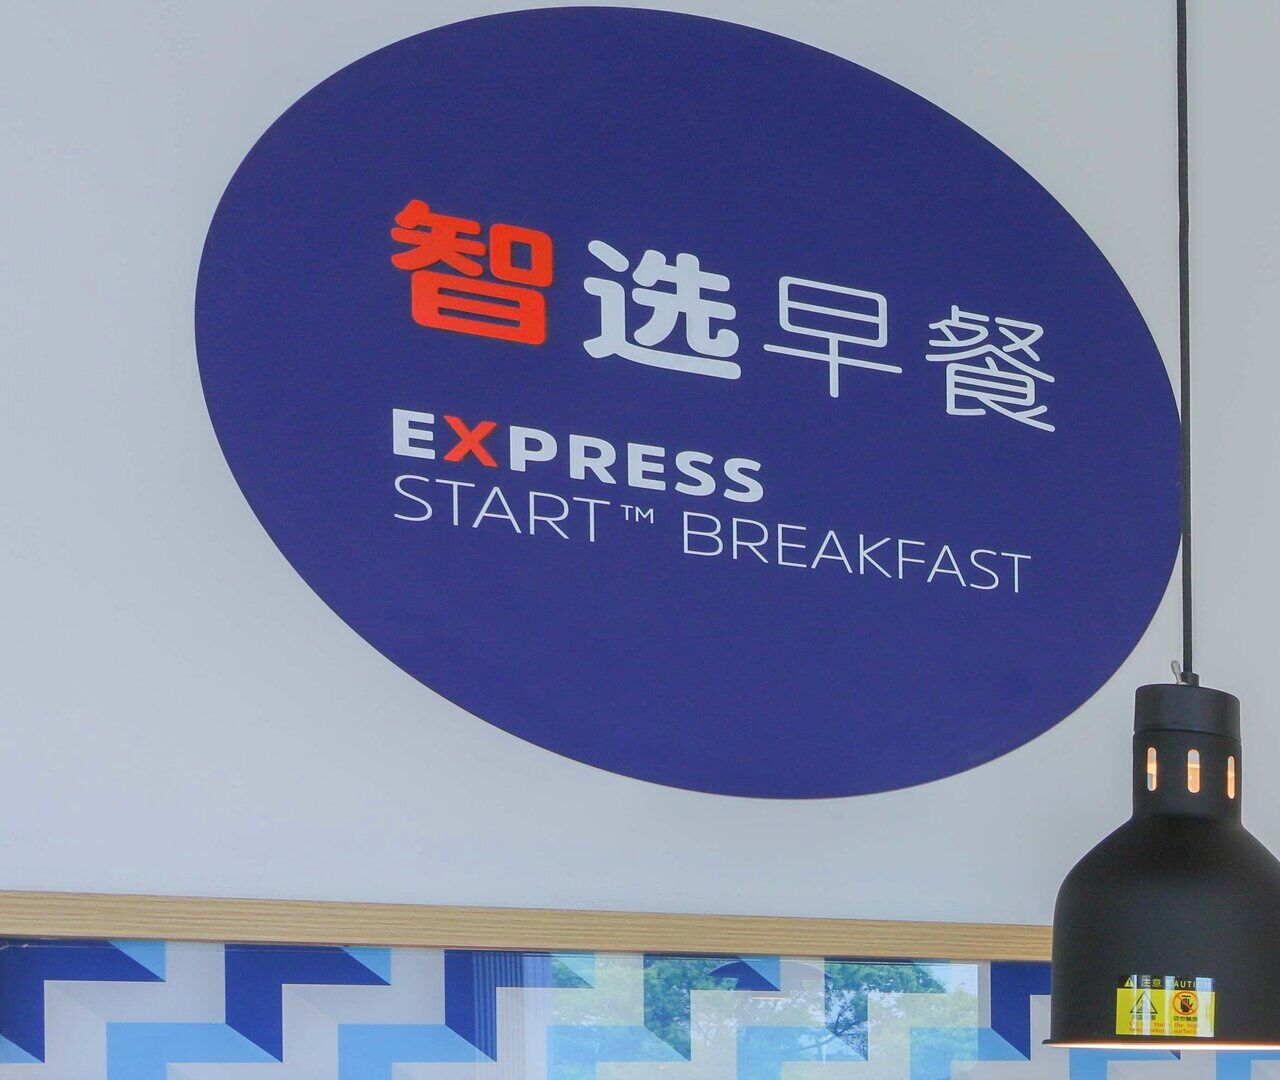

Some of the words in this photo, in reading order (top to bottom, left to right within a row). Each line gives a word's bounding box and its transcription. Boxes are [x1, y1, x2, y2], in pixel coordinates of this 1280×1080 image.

[391, 199, 1055, 432] 智选早餐
[392, 407, 764, 503] EXPRESS
[682, 510, 1031, 593] BREAKFAST
[1141, 978, 1162, 987] 注意
